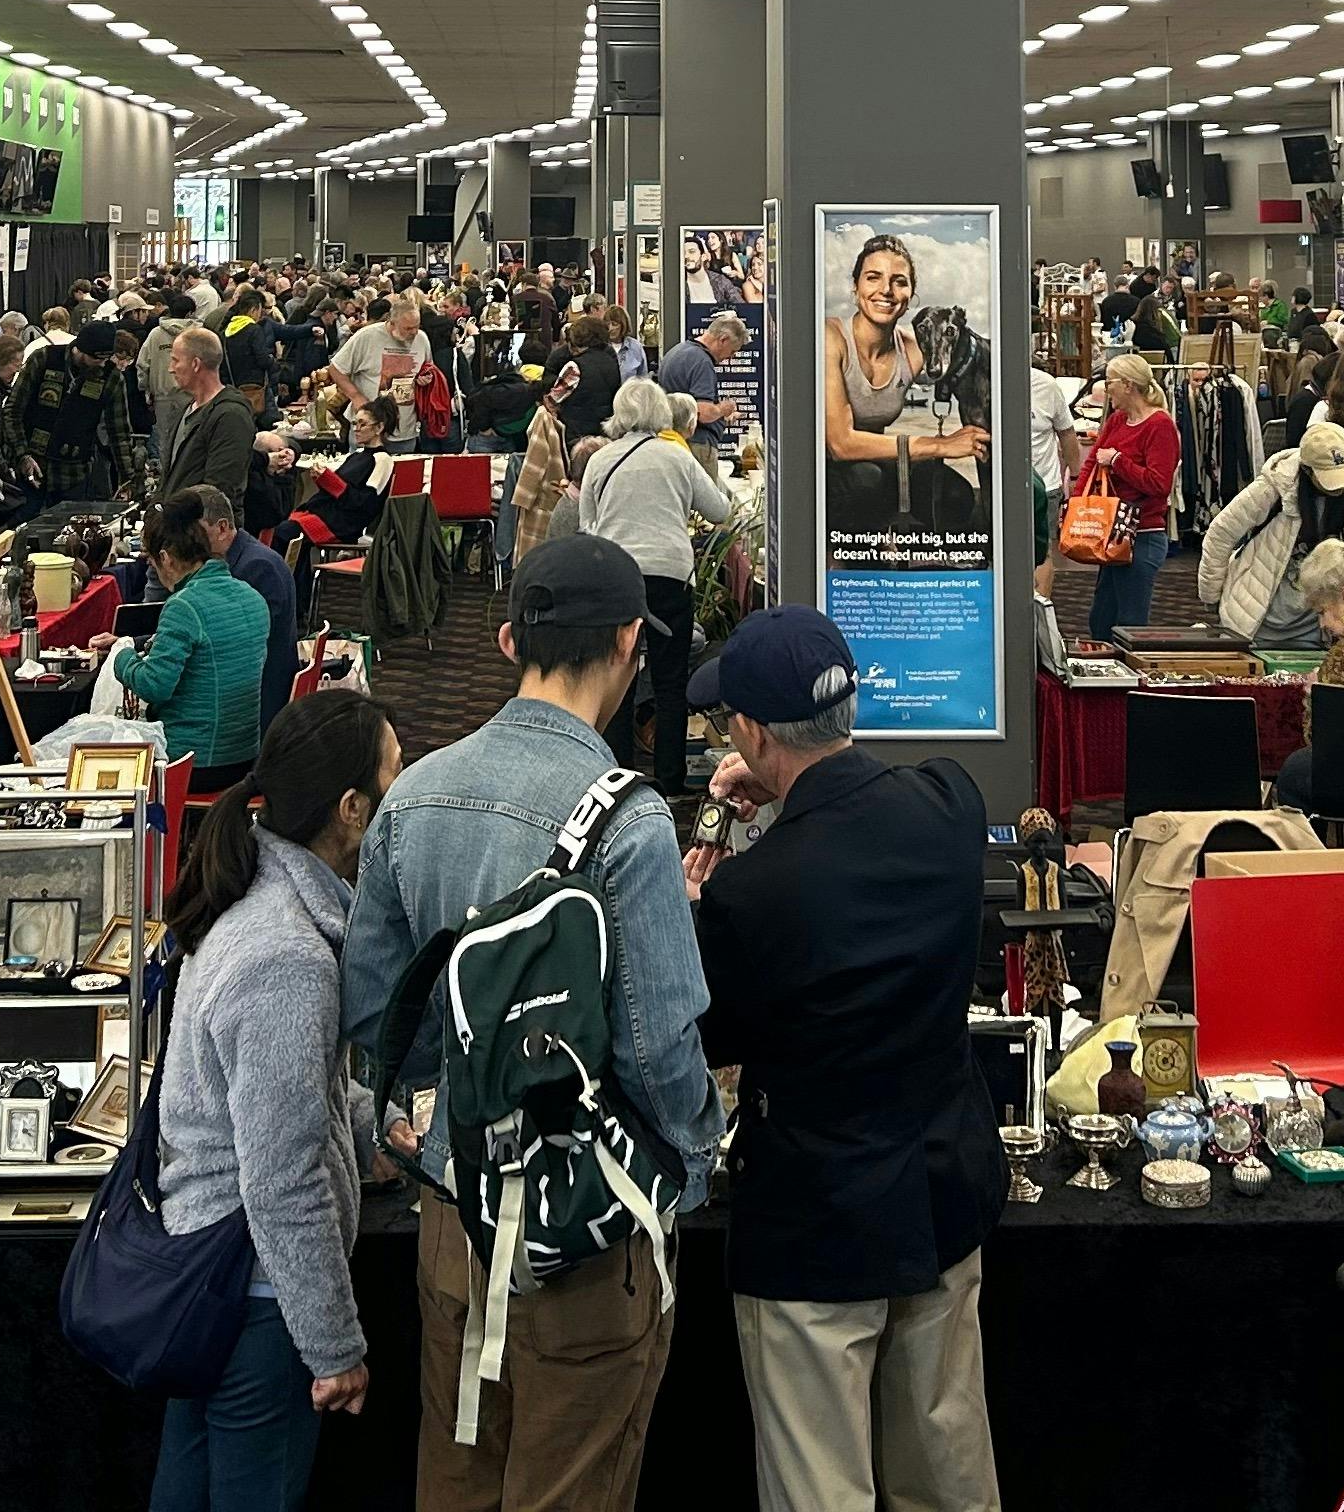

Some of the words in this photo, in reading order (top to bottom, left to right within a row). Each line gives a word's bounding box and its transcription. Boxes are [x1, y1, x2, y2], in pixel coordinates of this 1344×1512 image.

[830, 531, 852, 543] She
[855, 531, 891, 546] might
[893, 532, 920, 544] look
[922, 532, 943, 546] big,
[946, 532, 966, 544] but
[968, 532, 989, 544] she
[833, 548, 877, 560] doesn't
[880, 549, 910, 561] need
[913, 549, 946, 561] much
[950, 551, 986, 563] space.
[832, 579, 879, 588] Greyhounds.
[880, 579, 894, 588] The
[896, 579, 938, 588] unexpected
[940, 579, 966, 588] perfect
[966, 579, 981, 588] pet.
